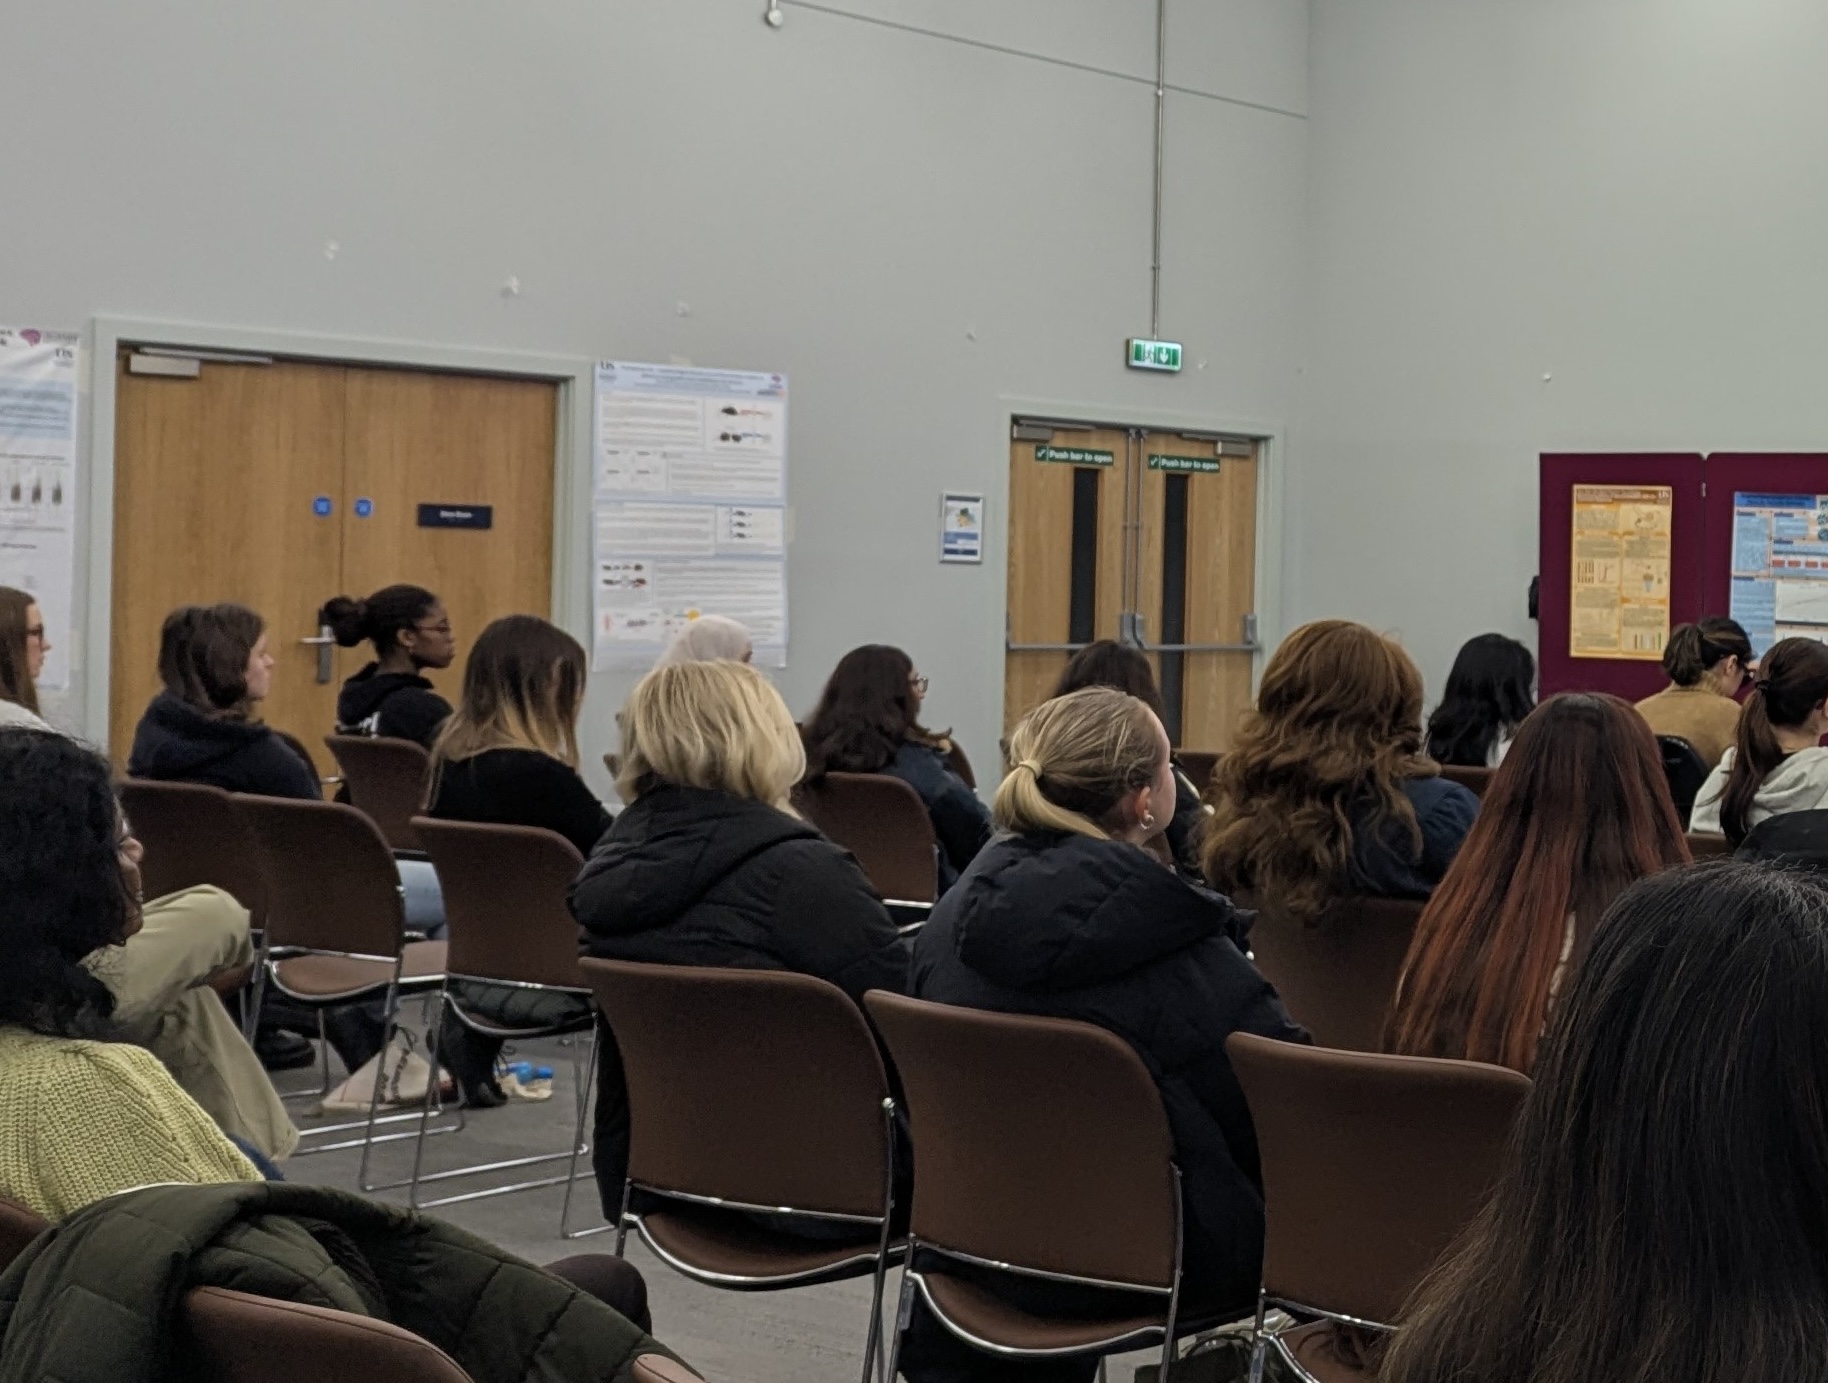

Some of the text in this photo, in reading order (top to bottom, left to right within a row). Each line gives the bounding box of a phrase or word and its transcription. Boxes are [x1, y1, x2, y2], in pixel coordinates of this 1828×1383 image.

[1049, 449, 1113, 463] Push bar to open
[1161, 458, 1220, 470] Push bar to open
